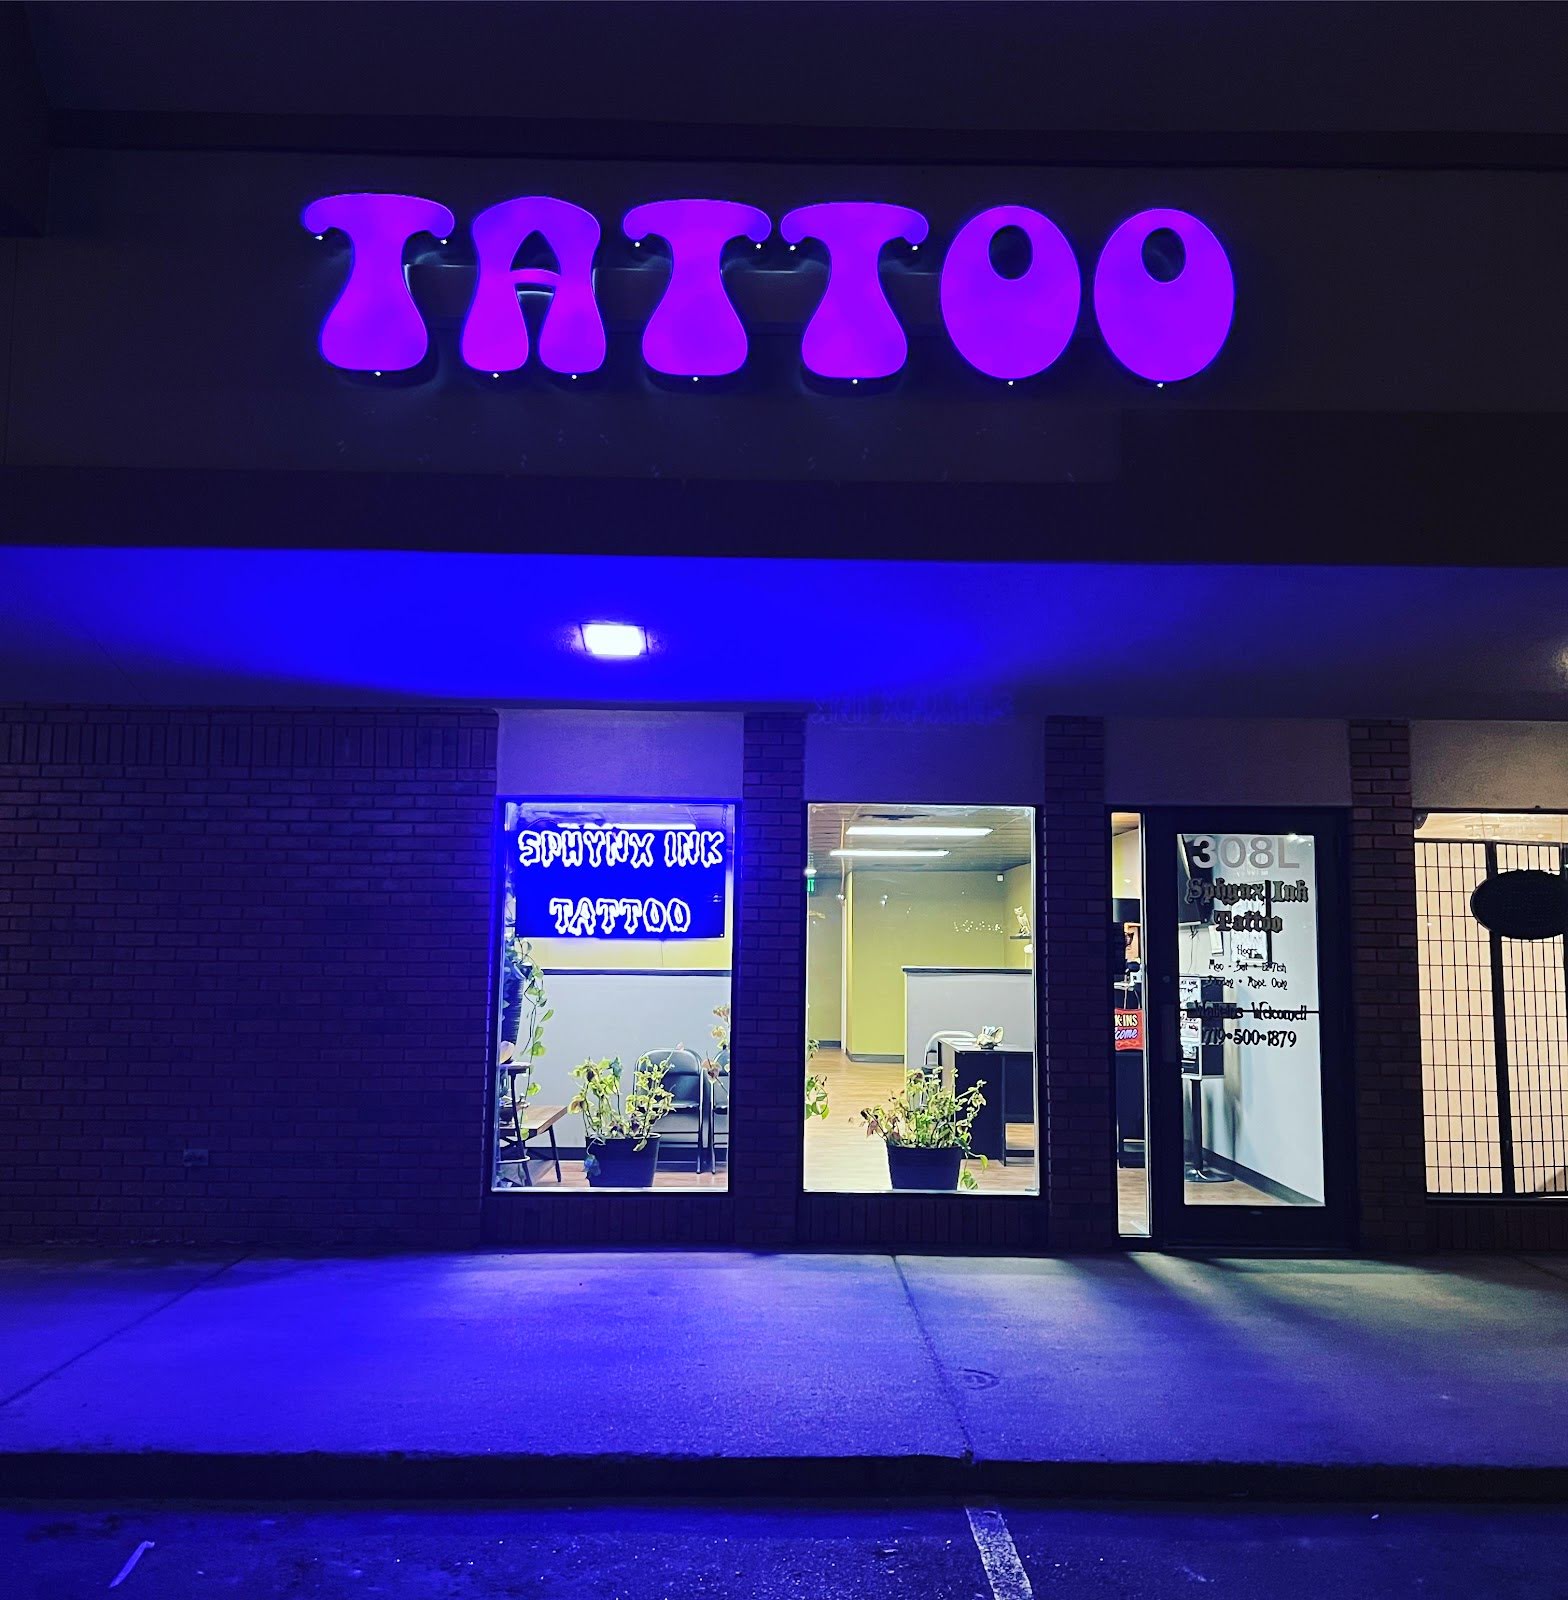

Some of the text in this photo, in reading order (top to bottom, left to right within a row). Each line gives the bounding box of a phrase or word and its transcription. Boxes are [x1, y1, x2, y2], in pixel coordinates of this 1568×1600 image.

[301, 193, 1236, 383] TATTOO
[518, 830, 725, 868] SPHYNX INK
[1193, 836, 1300, 868] 308L
[1185, 878, 1308, 906] Sphynx Ink
[550, 897, 691, 936] TATTOO
[1213, 910, 1283, 933] Tattoo
